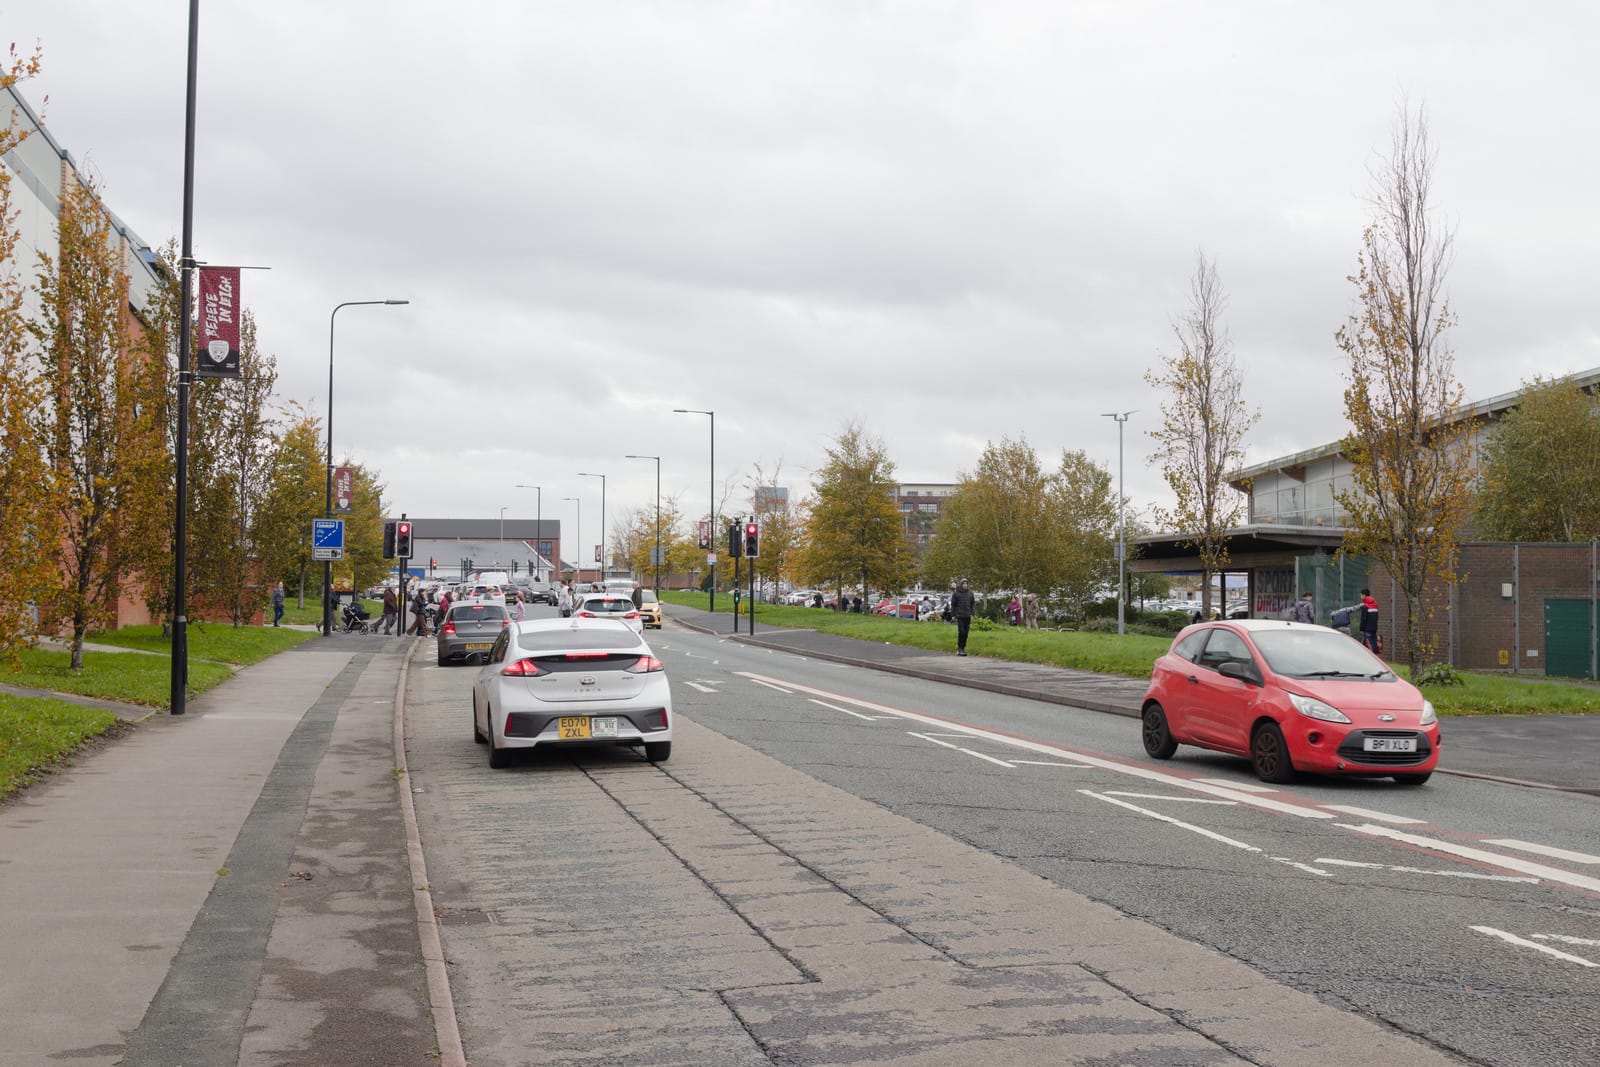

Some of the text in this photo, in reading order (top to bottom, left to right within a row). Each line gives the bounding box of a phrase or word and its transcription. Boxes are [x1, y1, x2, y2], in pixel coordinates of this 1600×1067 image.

[218, 276, 232, 323] IN LEIGH
[205, 292, 219, 338] BELIEVE
[1257, 570, 1295, 592] SPORT
[1257, 594, 1290, 612] DIRECT
[564, 728, 585, 738] ZXL
